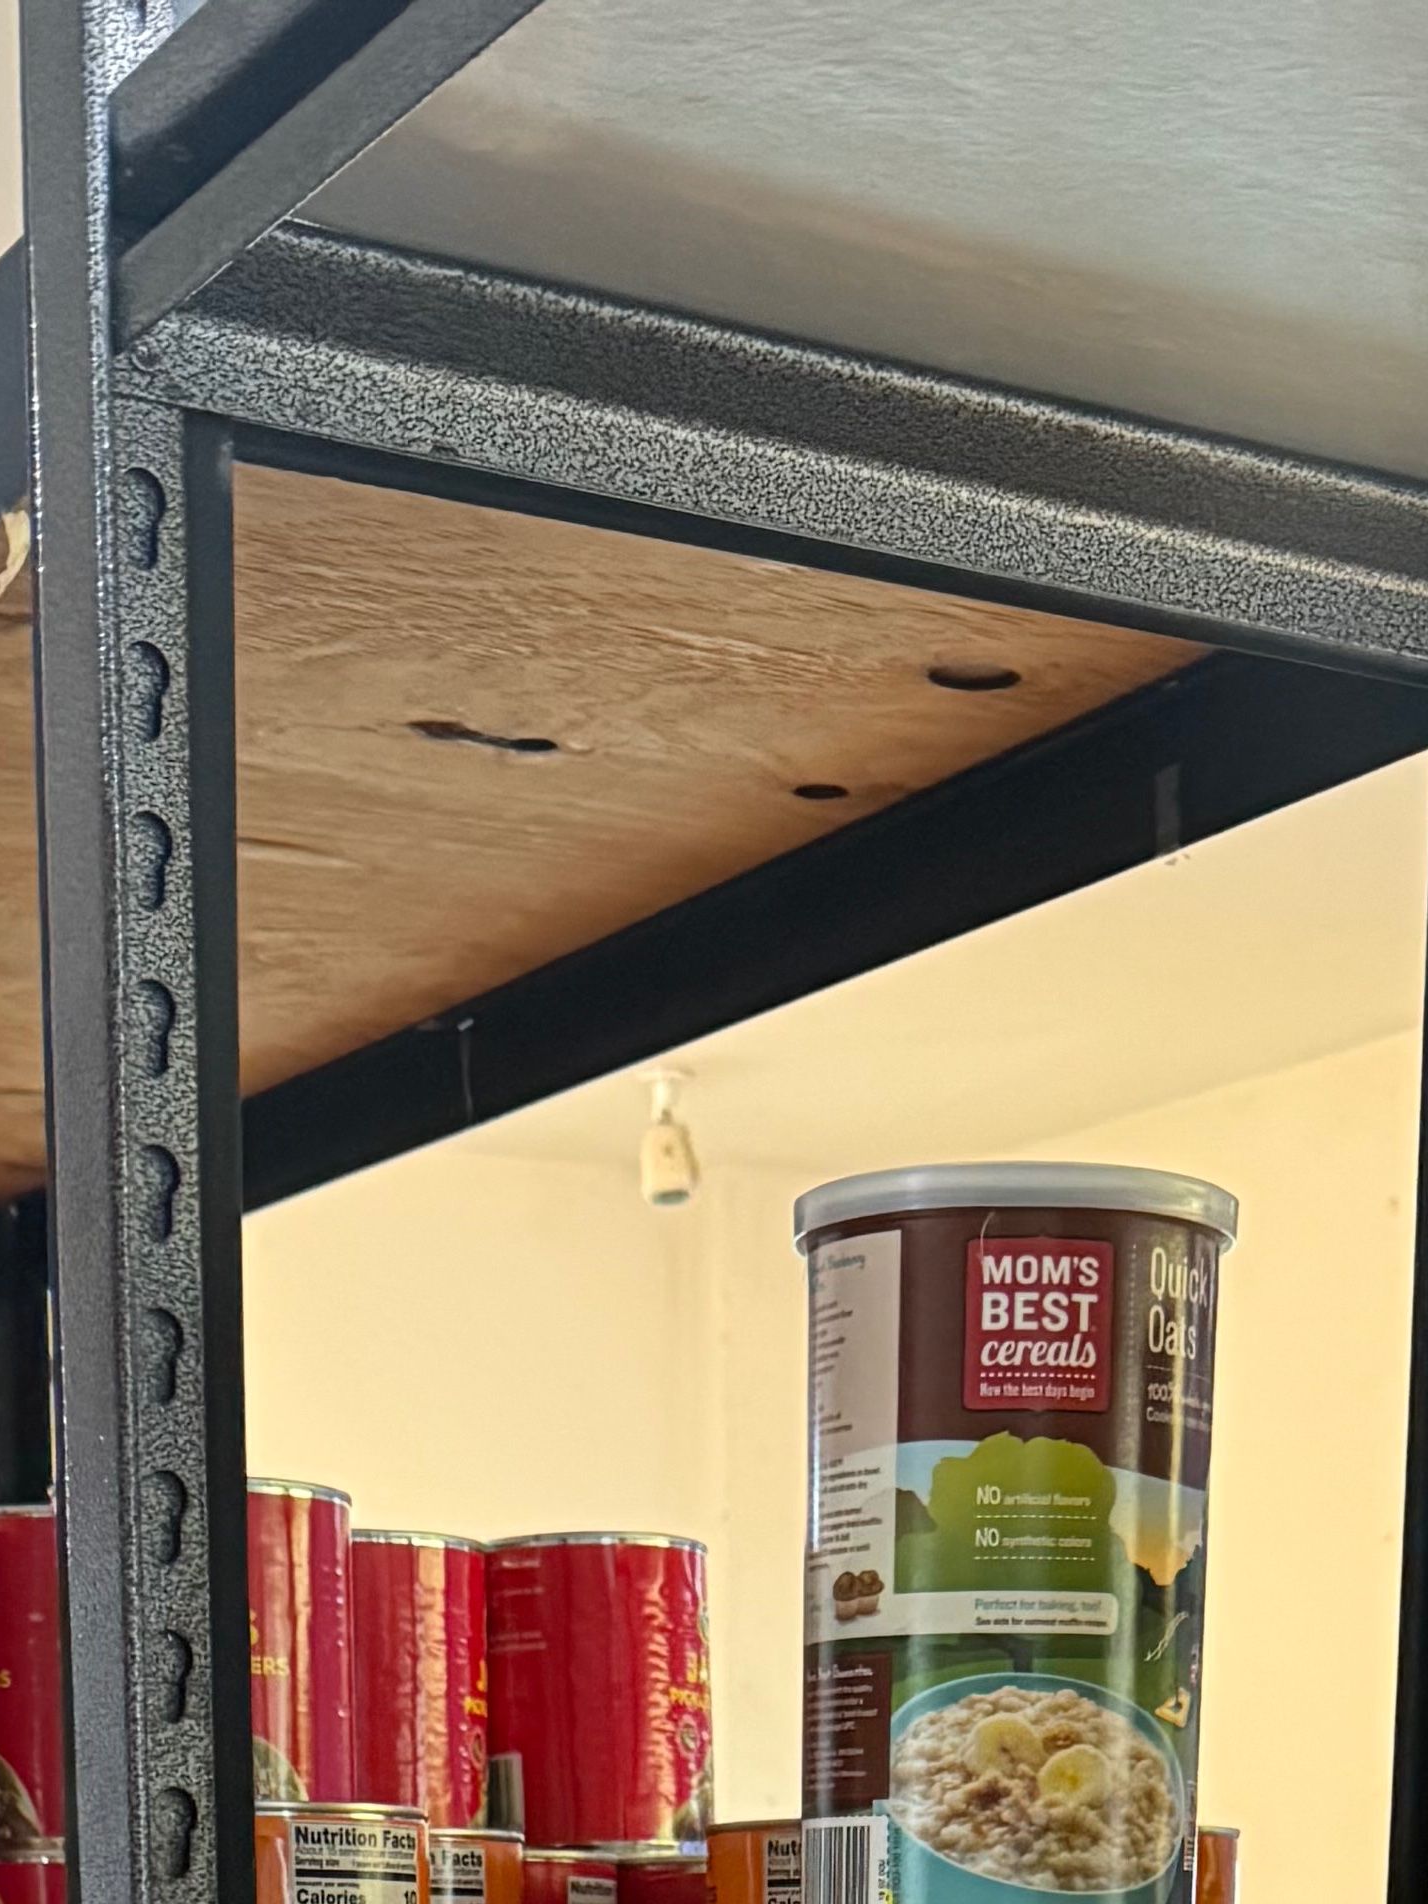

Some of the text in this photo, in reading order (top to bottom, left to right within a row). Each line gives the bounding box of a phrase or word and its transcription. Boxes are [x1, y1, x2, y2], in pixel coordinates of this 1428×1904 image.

[980, 1254, 1100, 1287] MOM'S
[1149, 1246, 1209, 1309] Quick
[980, 1290, 1099, 1333] BEST
[1147, 1303, 1199, 1361] Oats
[979, 1332, 1097, 1369] cereals
[1003, 1383, 1020, 1397] the
[1022, 1383, 1044, 1397] best
[1045, 1383, 1068, 1401] days
[976, 1485, 1002, 1506] NO
[974, 1527, 1000, 1548] NO
[294, 1825, 378, 1849] Nutrition
